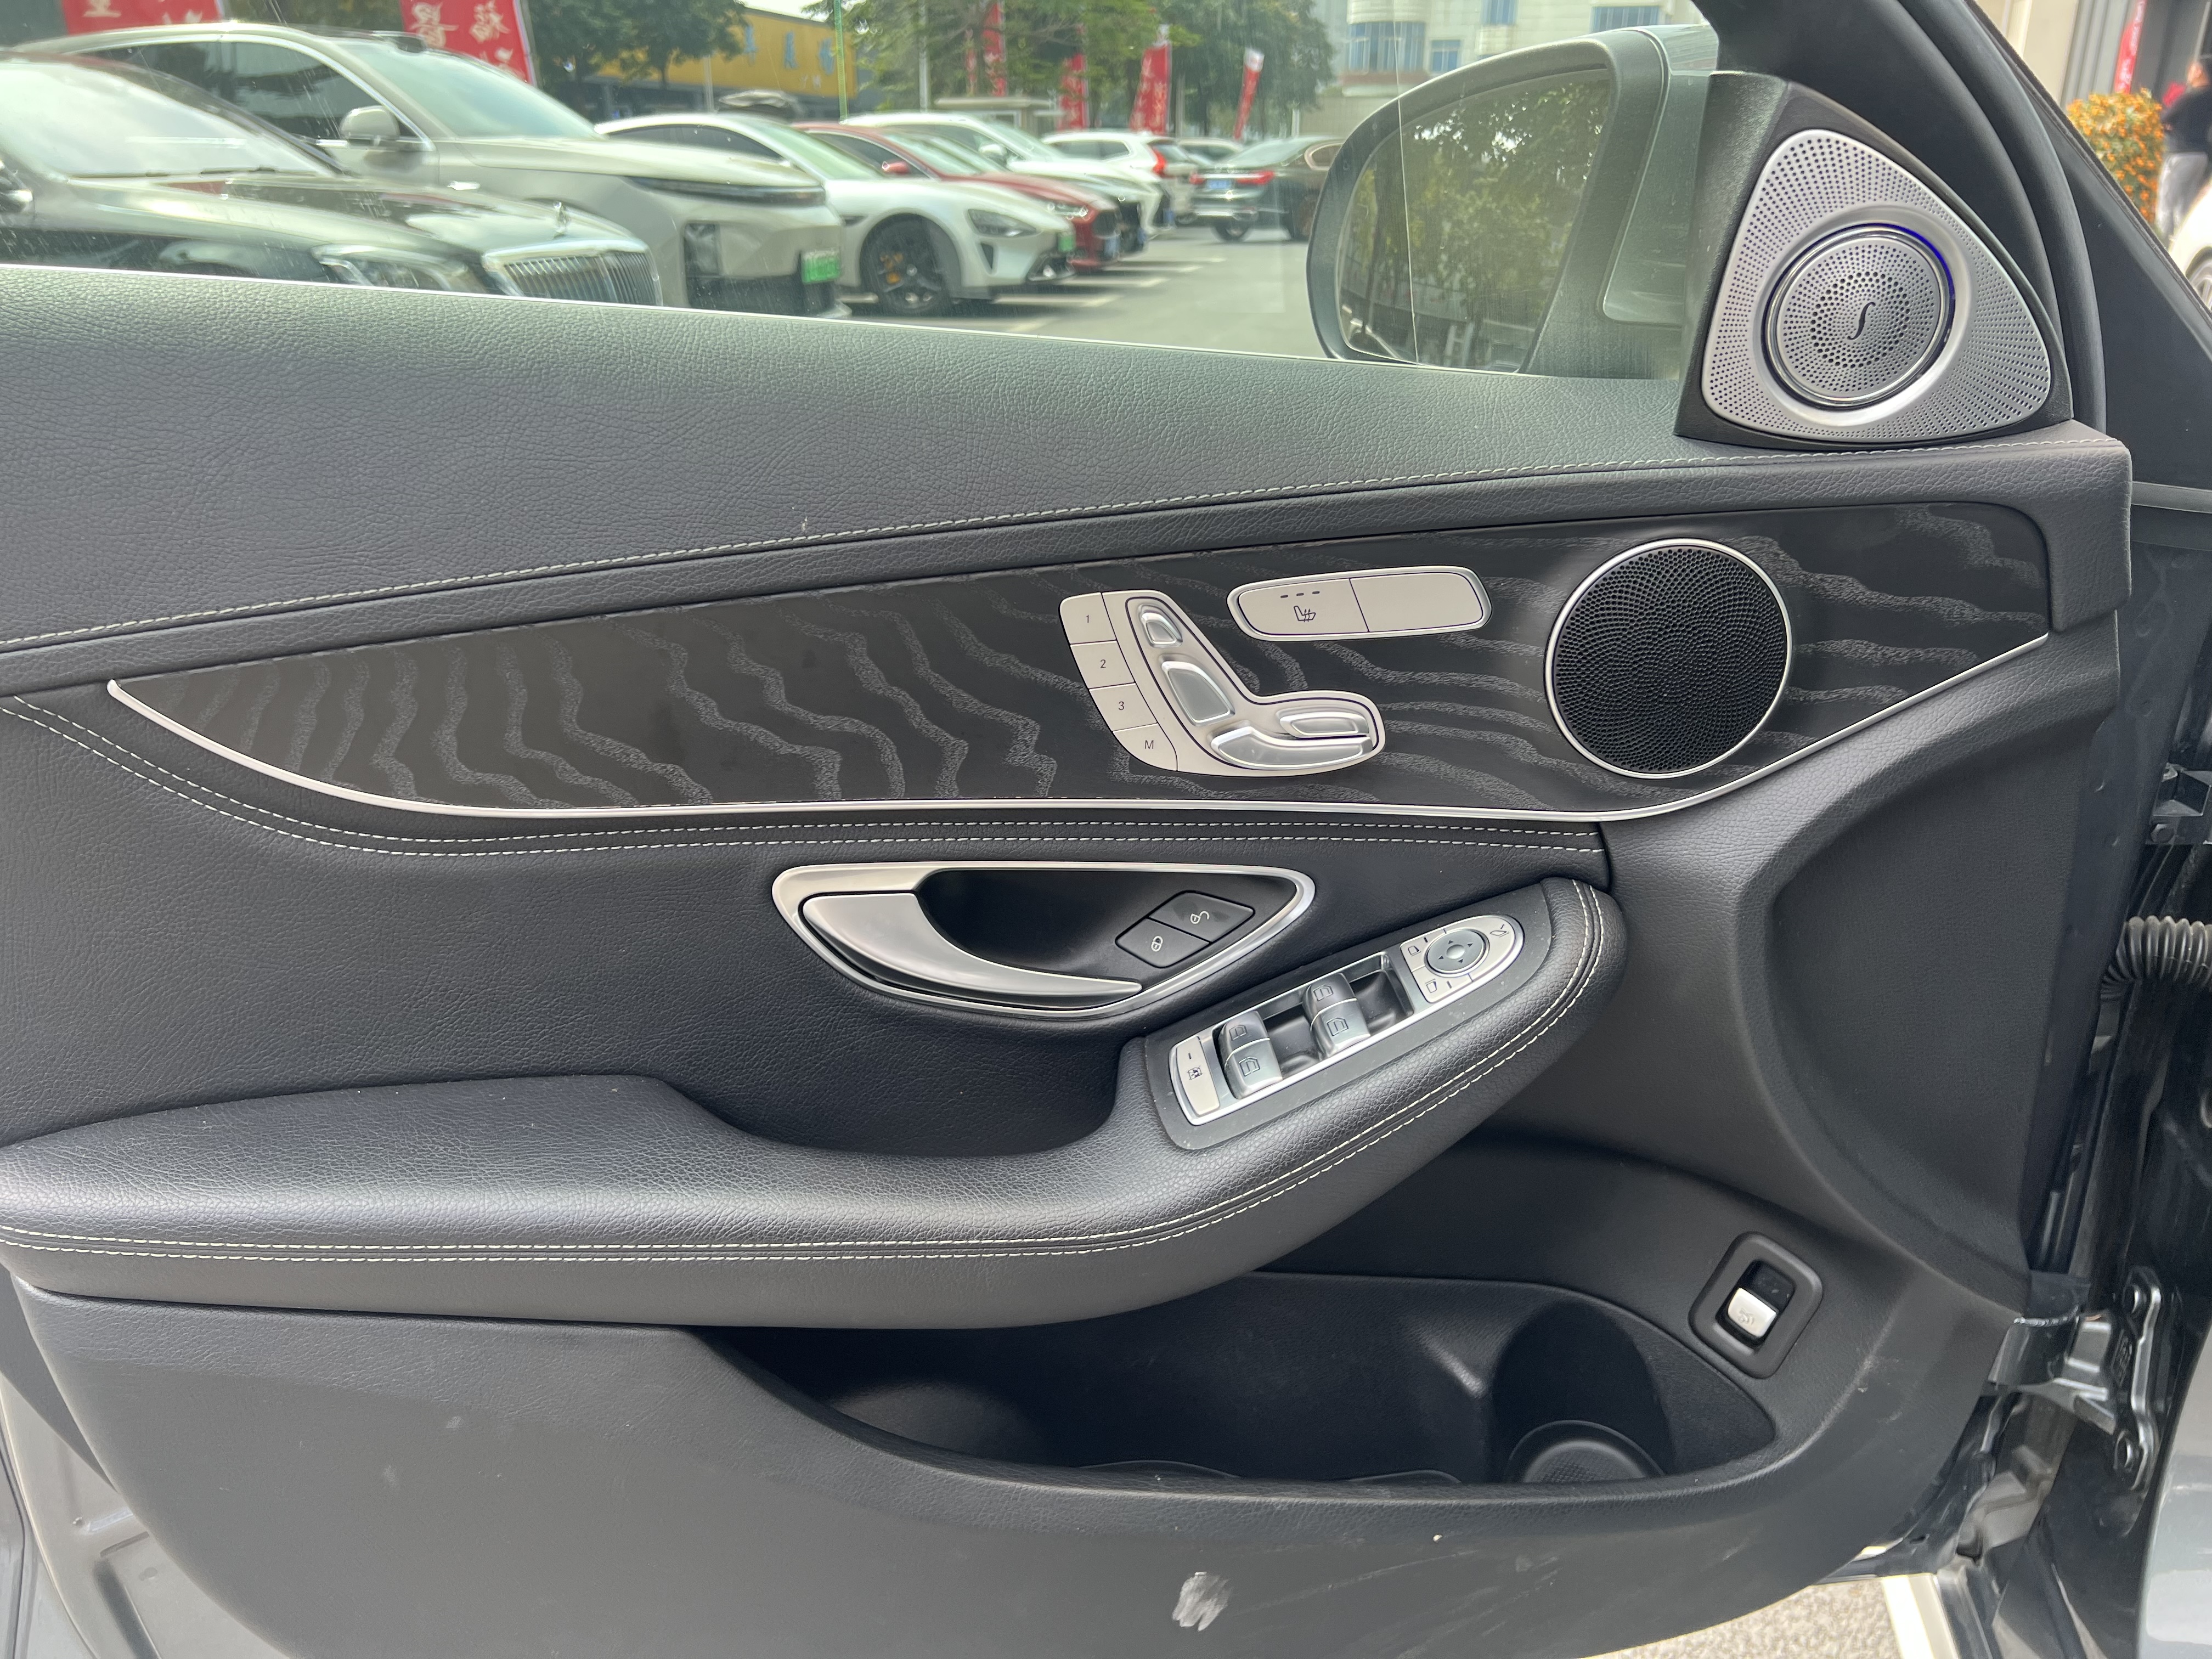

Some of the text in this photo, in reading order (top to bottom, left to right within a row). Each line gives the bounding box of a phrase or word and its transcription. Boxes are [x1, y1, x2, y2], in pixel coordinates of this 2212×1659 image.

[1100, 659, 1107, 669] 2
[1118, 701, 1125, 710] 3
[1144, 740, 1155, 750] M
